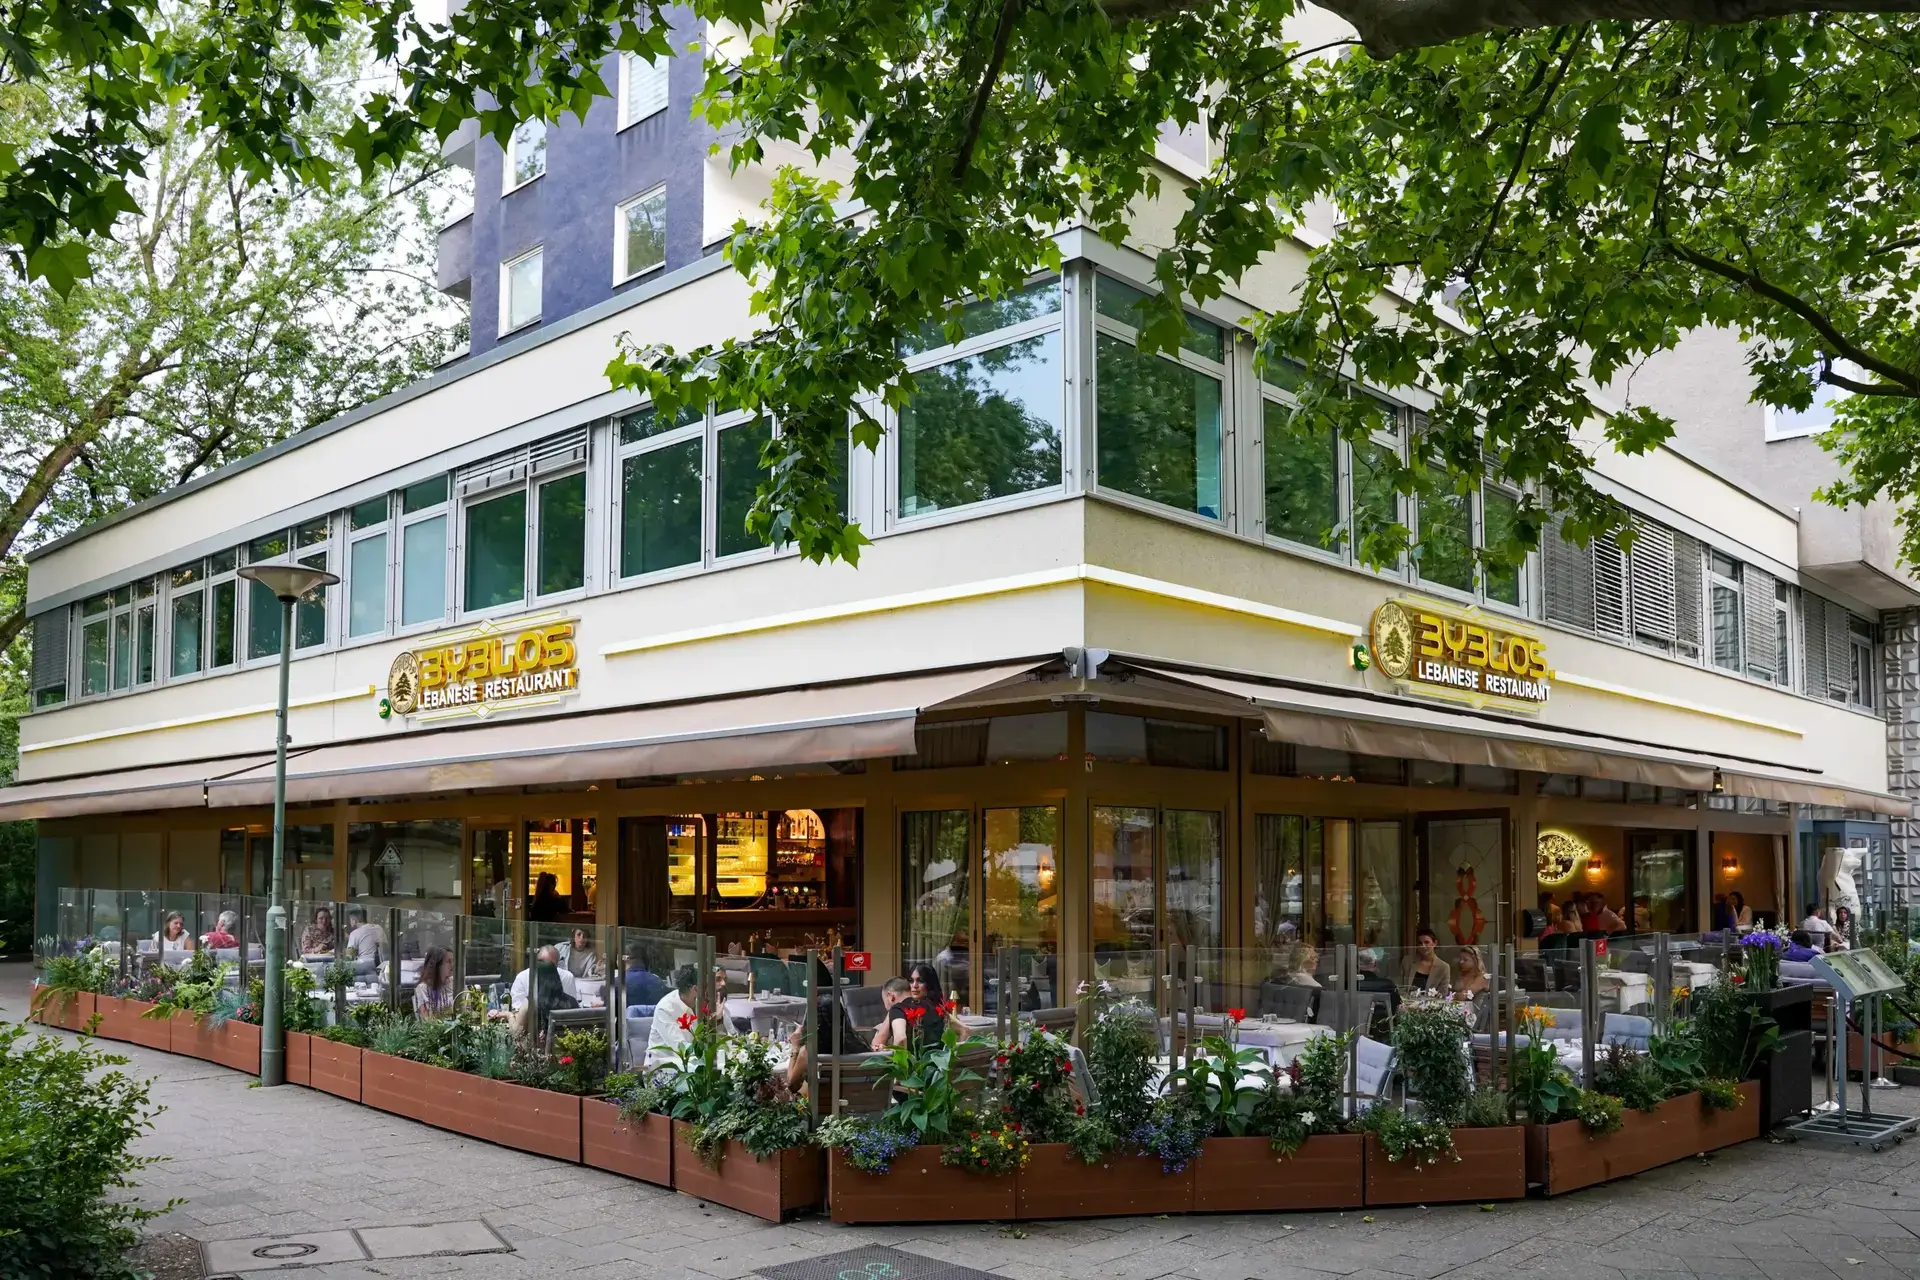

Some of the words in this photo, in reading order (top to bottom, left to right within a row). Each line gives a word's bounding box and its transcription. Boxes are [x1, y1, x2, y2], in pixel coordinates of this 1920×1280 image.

[420, 623, 570, 688] BYBLOS
[1420, 613, 1547, 678] BYBLOS
[417, 684, 478, 709] LEBANESE
[485, 668, 571, 698] RESTAURANT
[1418, 660, 1479, 689] LEBANESE
[1485, 673, 1551, 701] RESTAURANT
